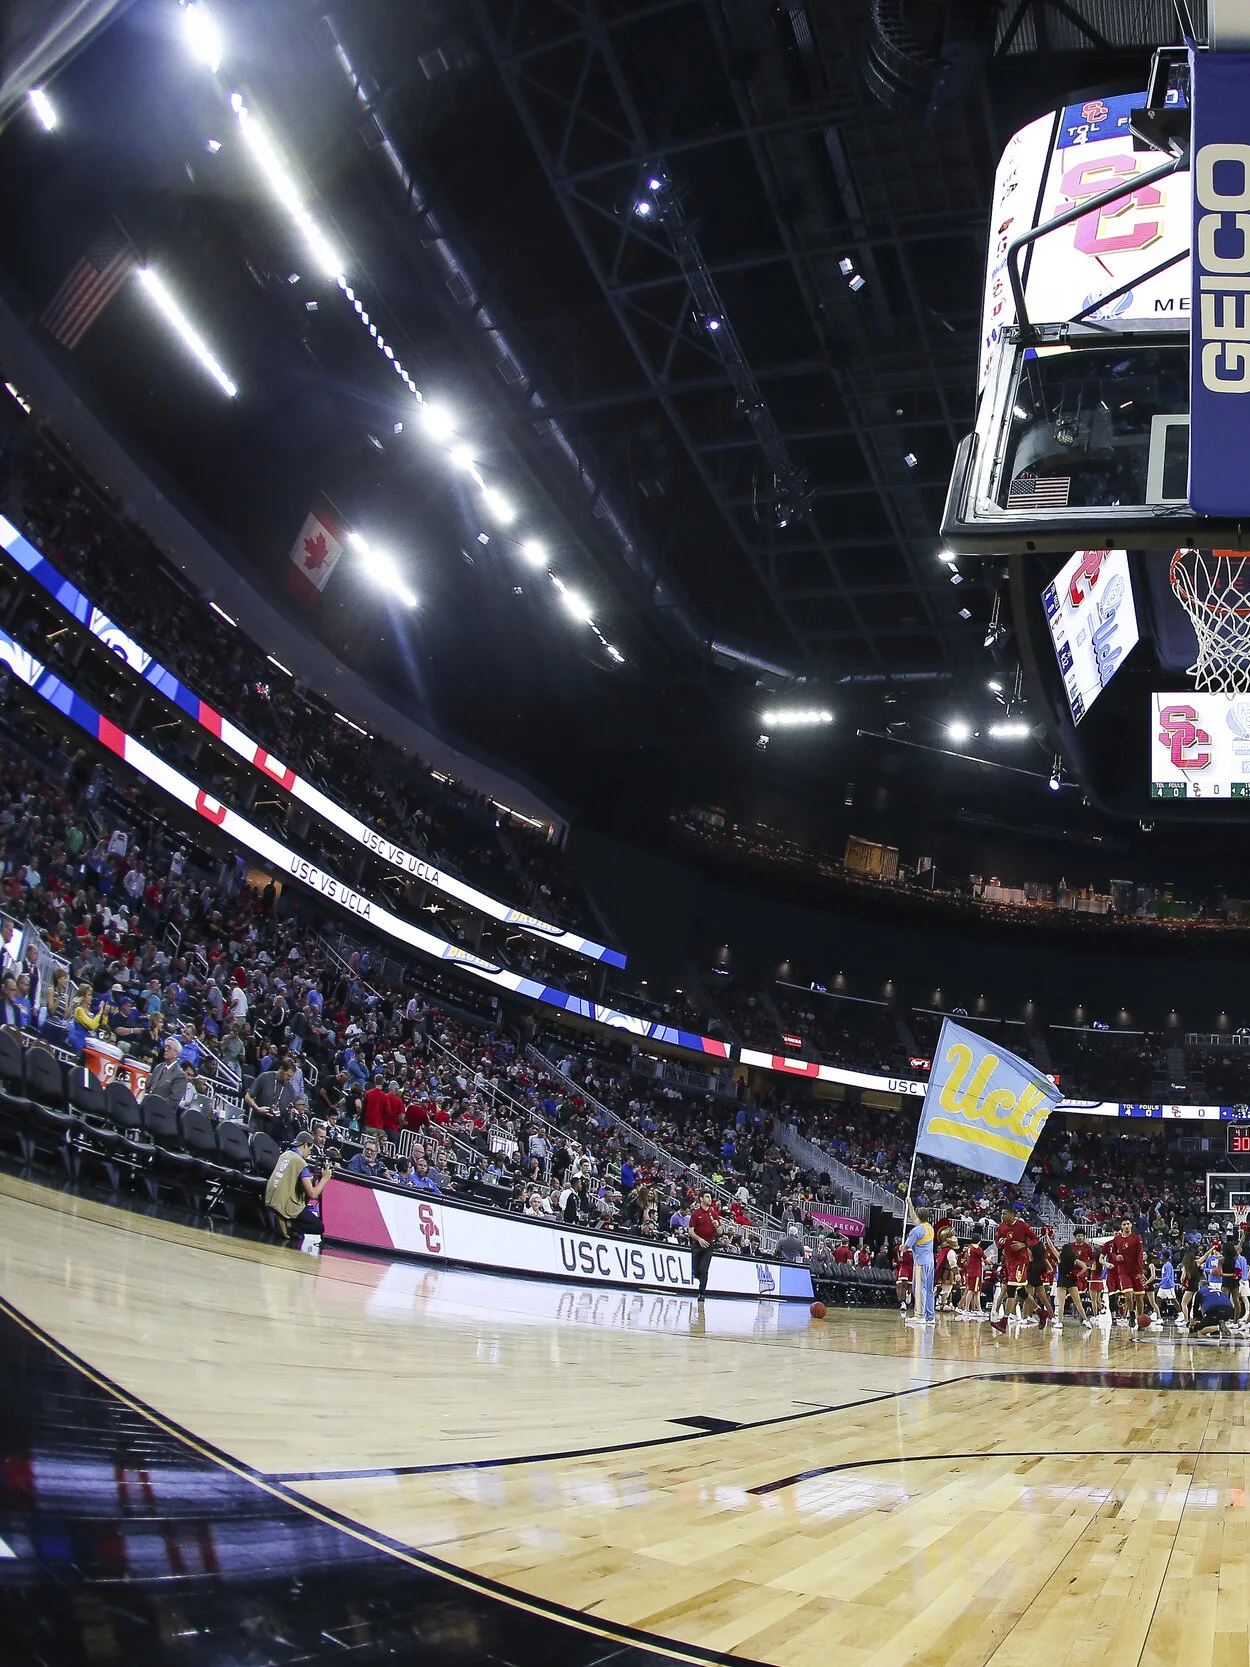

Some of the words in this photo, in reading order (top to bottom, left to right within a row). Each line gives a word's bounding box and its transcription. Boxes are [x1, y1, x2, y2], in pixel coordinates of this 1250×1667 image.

[1067, 122, 1100, 137] TOL
[1072, 132, 1089, 145] 4
[1159, 705, 1212, 770] SC
[1157, 788, 1163, 797] 4
[1213, 784, 1220, 795] 0
[363, 829, 386, 855] USC
[388, 845, 405, 866] VS
[408, 857, 439, 886] UCLA
[290, 855, 318, 885] USC
[321, 874, 338, 897] VS
[340, 887, 371, 919] UCLA
[888, 1080, 918, 1094] USC
[1145, 1109, 1152, 1117] 0
[1171, 1105, 1182, 1118] SC
[1198, 1109, 1206, 1118] 0
[1233, 1137, 1250, 1151] 30
[418, 1203, 441, 1253] SC
[833, 1222, 860, 1232] ARENA
[560, 1237, 611, 1276] USC
[615, 1246, 646, 1280] VS
[651, 1252, 695, 1286] UCL
